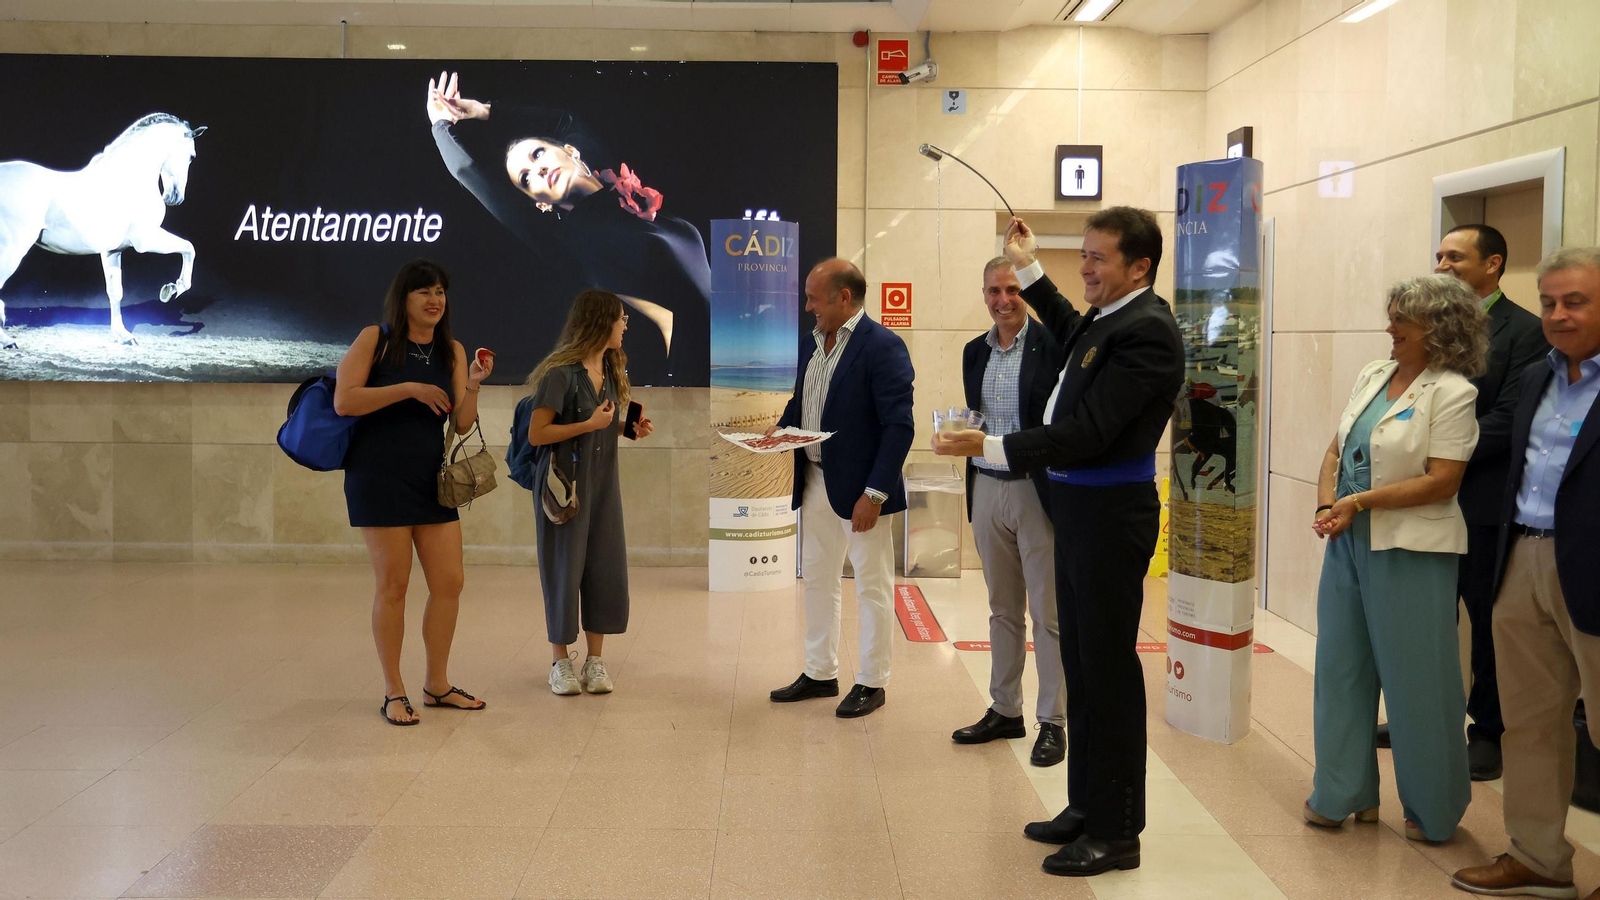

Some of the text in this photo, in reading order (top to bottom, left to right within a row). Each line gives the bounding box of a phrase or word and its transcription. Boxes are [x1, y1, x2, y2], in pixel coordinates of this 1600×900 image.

[1177, 181, 1229, 217] DIZ
[234, 204, 443, 243] Atentamente
[725, 229, 794, 258] CÁDIZ
[738, 262, 788, 273] PROVINCIA
[725, 528, 792, 538] www.cadizturismo.com
[743, 569, 782, 577] @CadizTurismo
